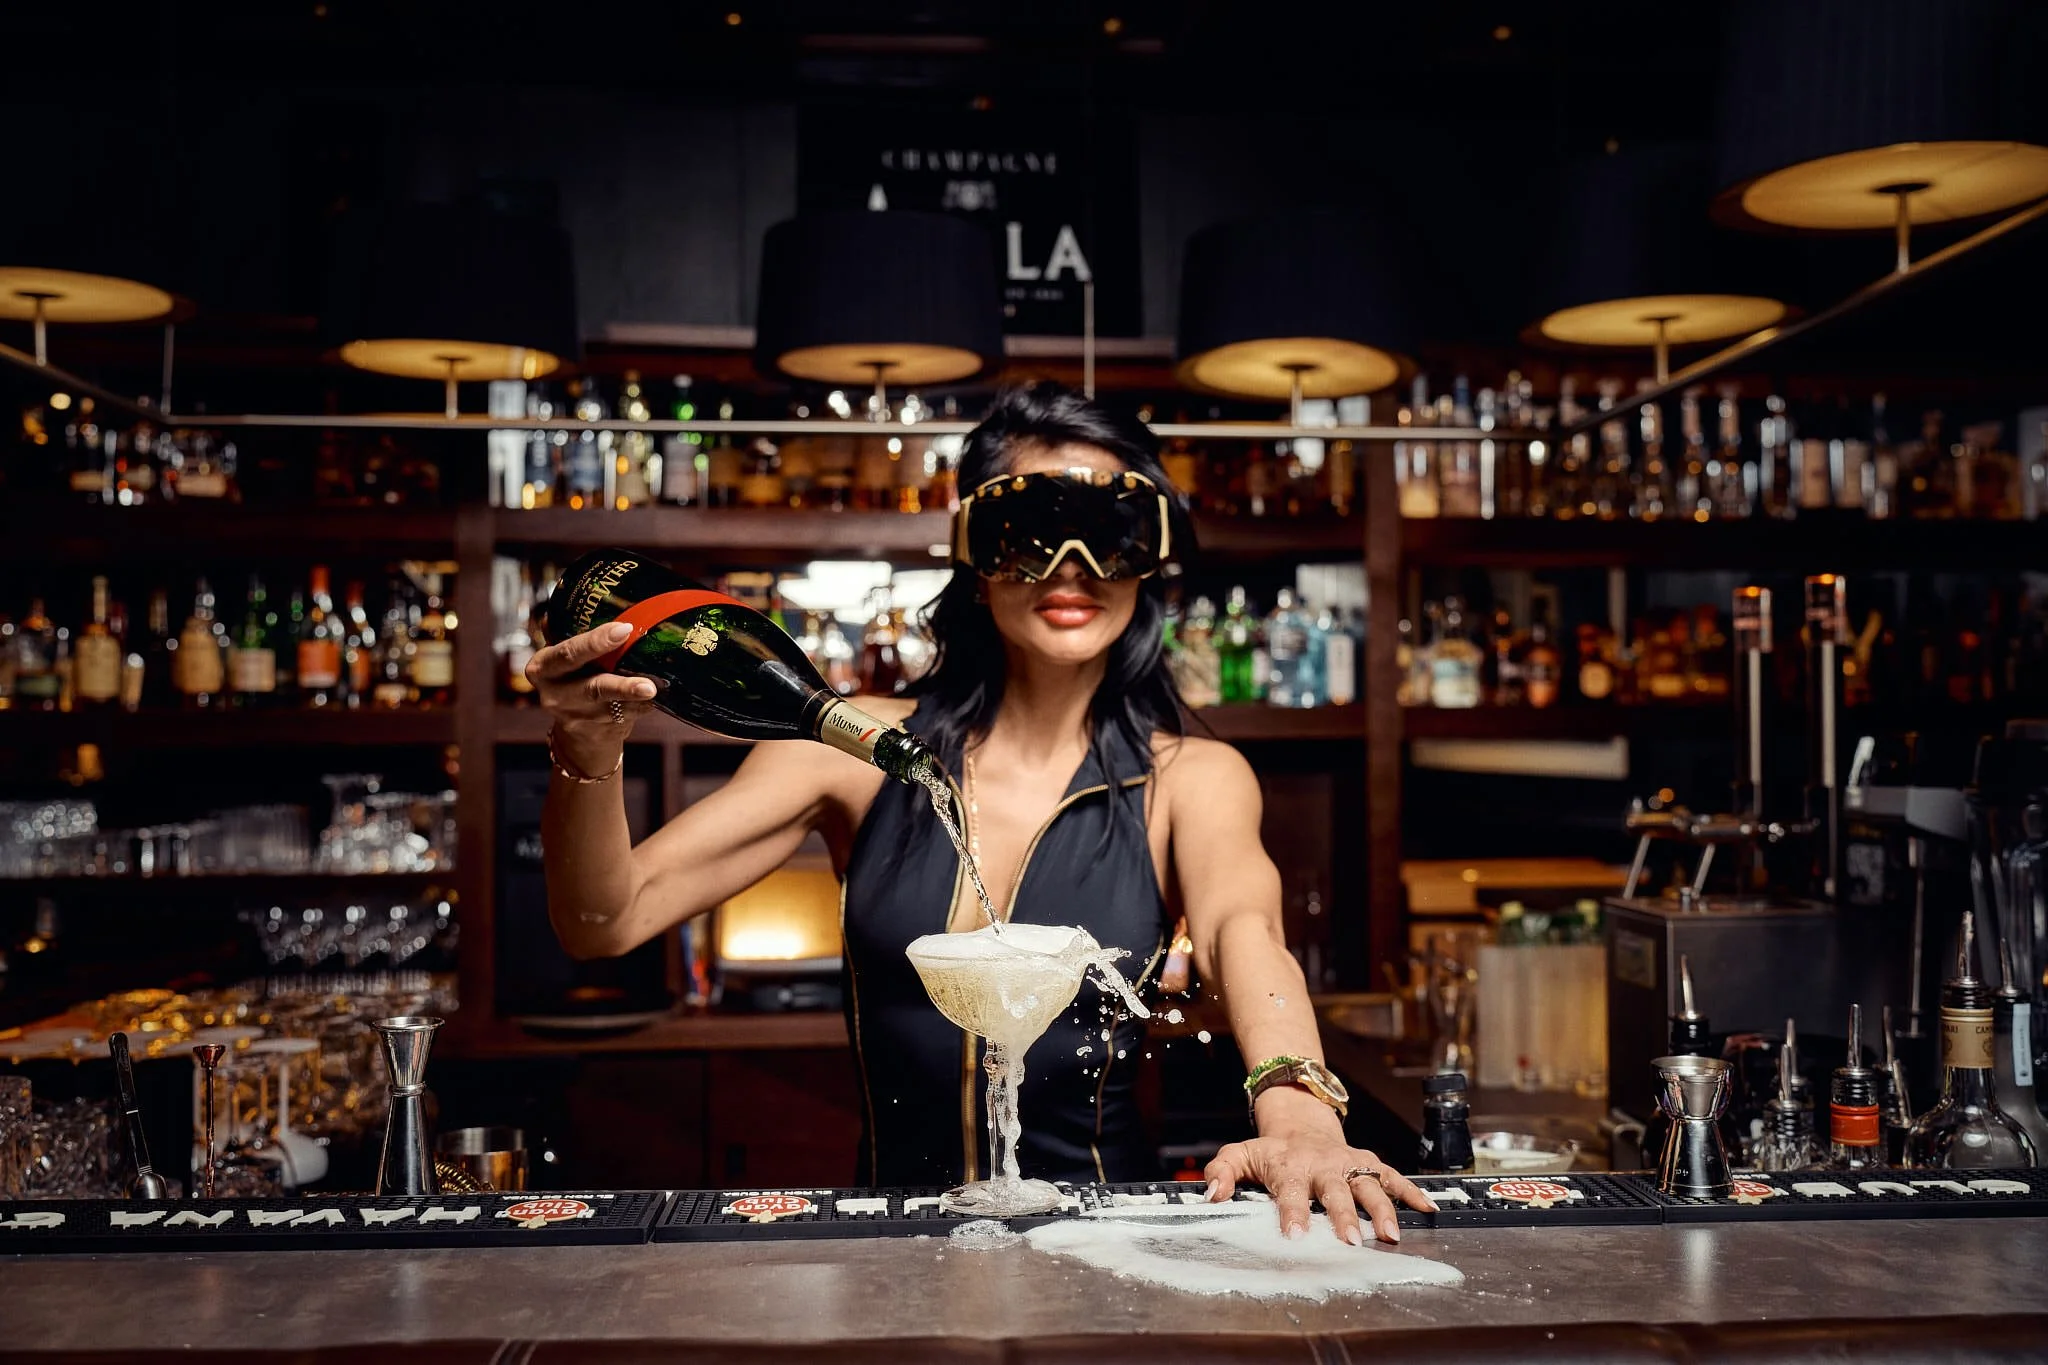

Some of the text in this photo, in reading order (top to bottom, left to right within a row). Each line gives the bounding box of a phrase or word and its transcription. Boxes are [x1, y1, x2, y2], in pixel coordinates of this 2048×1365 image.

[522, 1201, 579, 1209] Club
[110, 1206, 482, 1230] HAVANA
[494, 1208, 596, 1219] Havana
